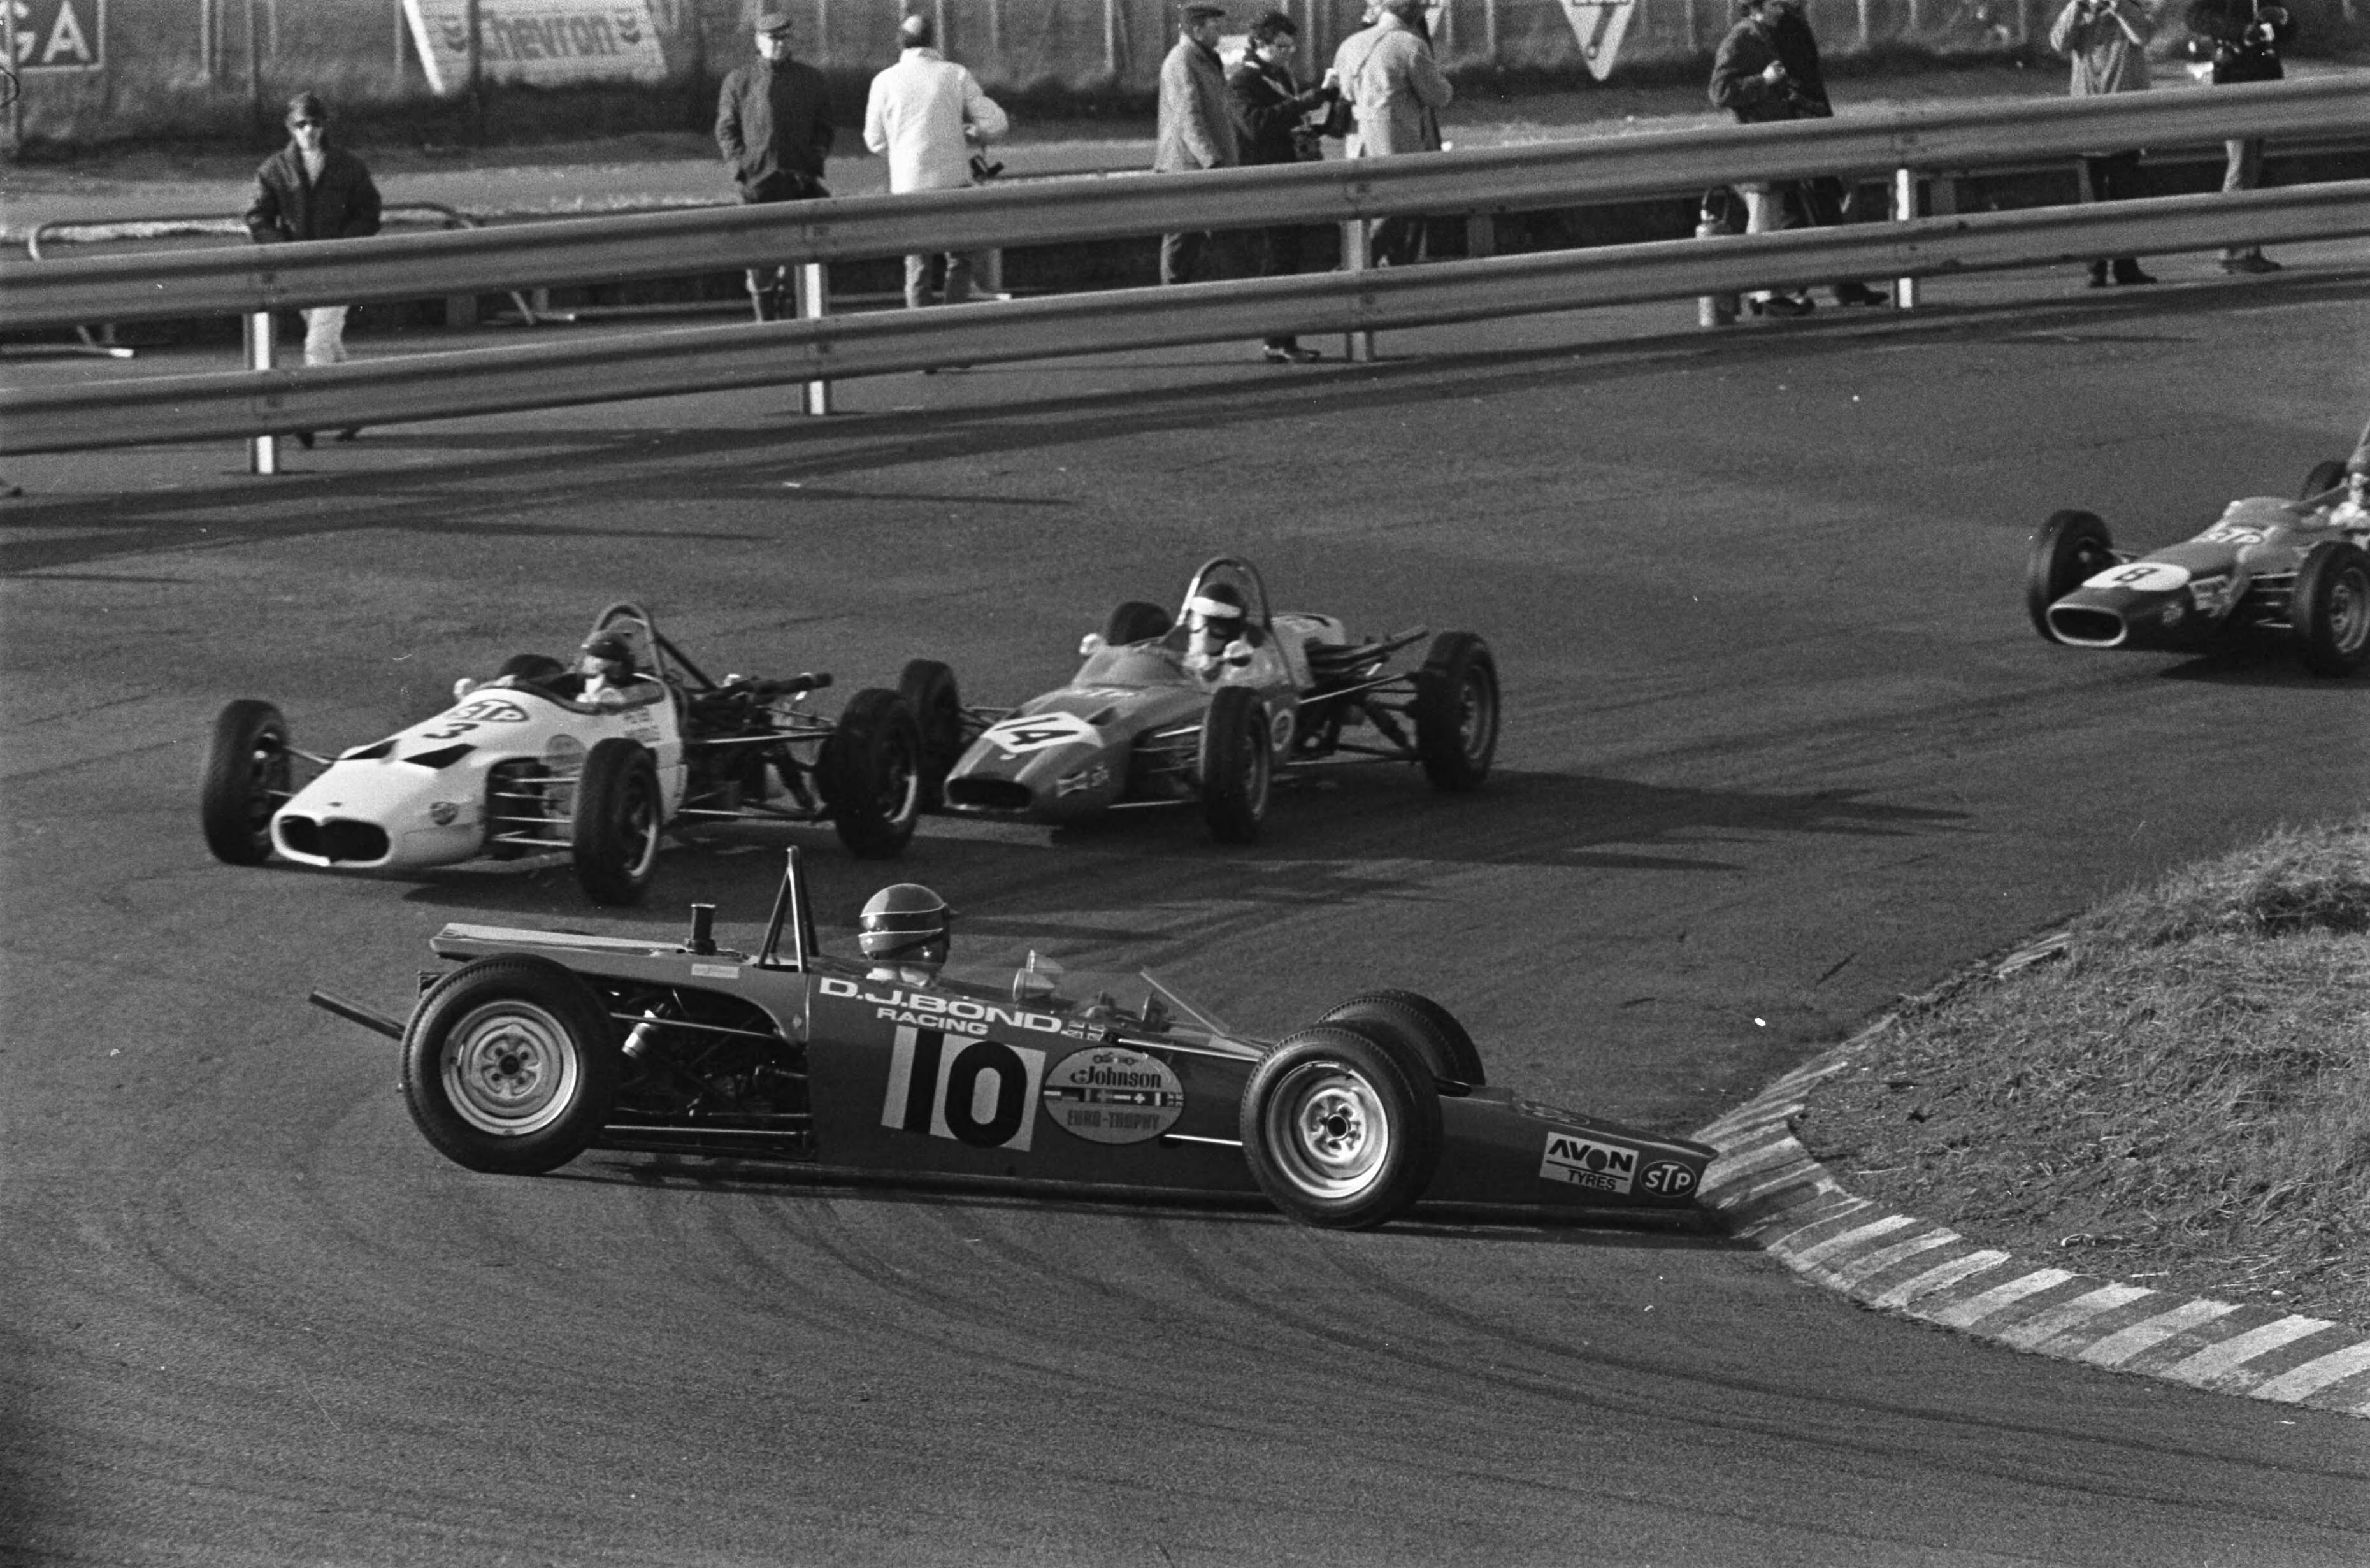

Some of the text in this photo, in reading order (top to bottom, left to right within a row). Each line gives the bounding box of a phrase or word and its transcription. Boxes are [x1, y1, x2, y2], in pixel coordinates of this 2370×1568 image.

[448, 700, 526, 722] STP
[877, 1007, 988, 1035] RACING
[1070, 1066, 1161, 1088] Johnson
[1548, 1139, 1633, 1172] AVON
[1568, 1169, 1616, 1191] TYRES
[1646, 1164, 1690, 1192] STP
